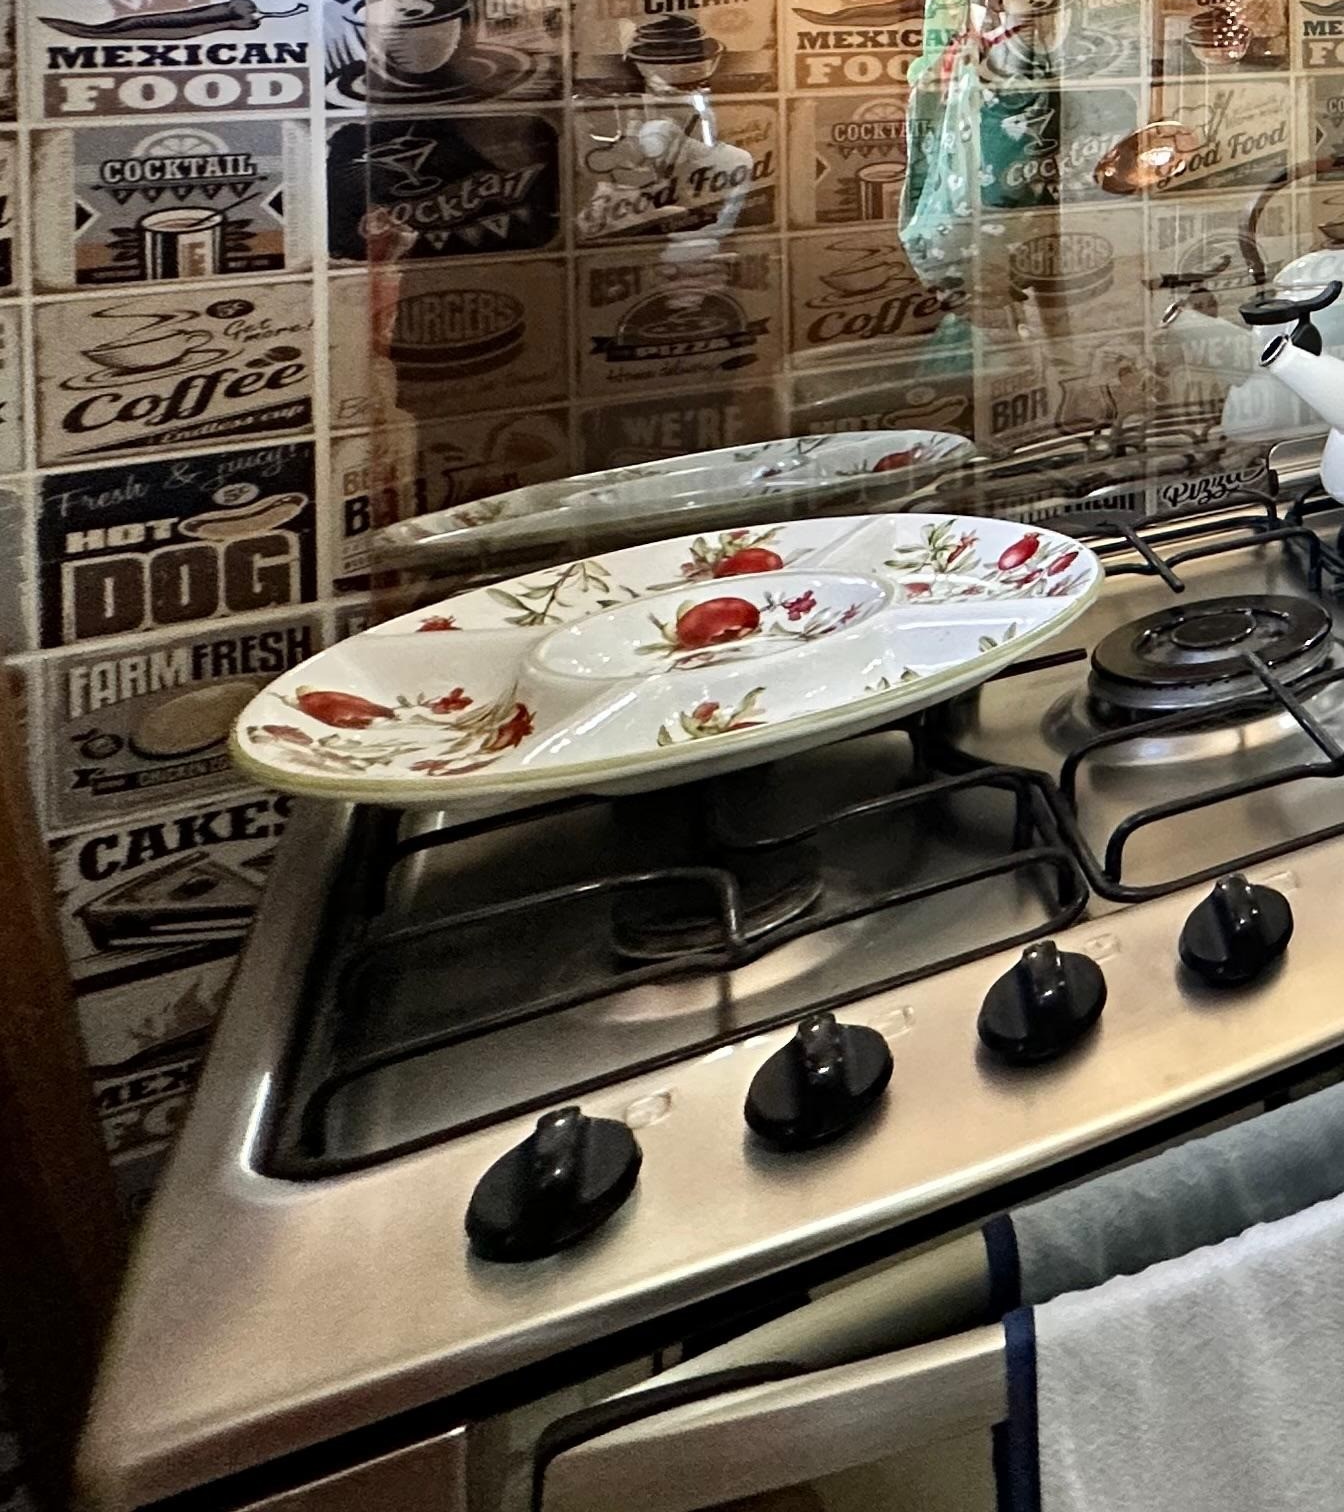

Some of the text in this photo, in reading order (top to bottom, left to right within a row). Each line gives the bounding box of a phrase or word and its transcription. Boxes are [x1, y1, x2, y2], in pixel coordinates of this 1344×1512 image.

[48, 43, 308, 69] MEXICAN
[61, 72, 303, 111] FOOD
[104, 155, 254, 183] COCKTAIL
[63, 363, 307, 434] Coffee
[66, 517, 178, 552] HOT
[70, 538, 292, 638] DOG
